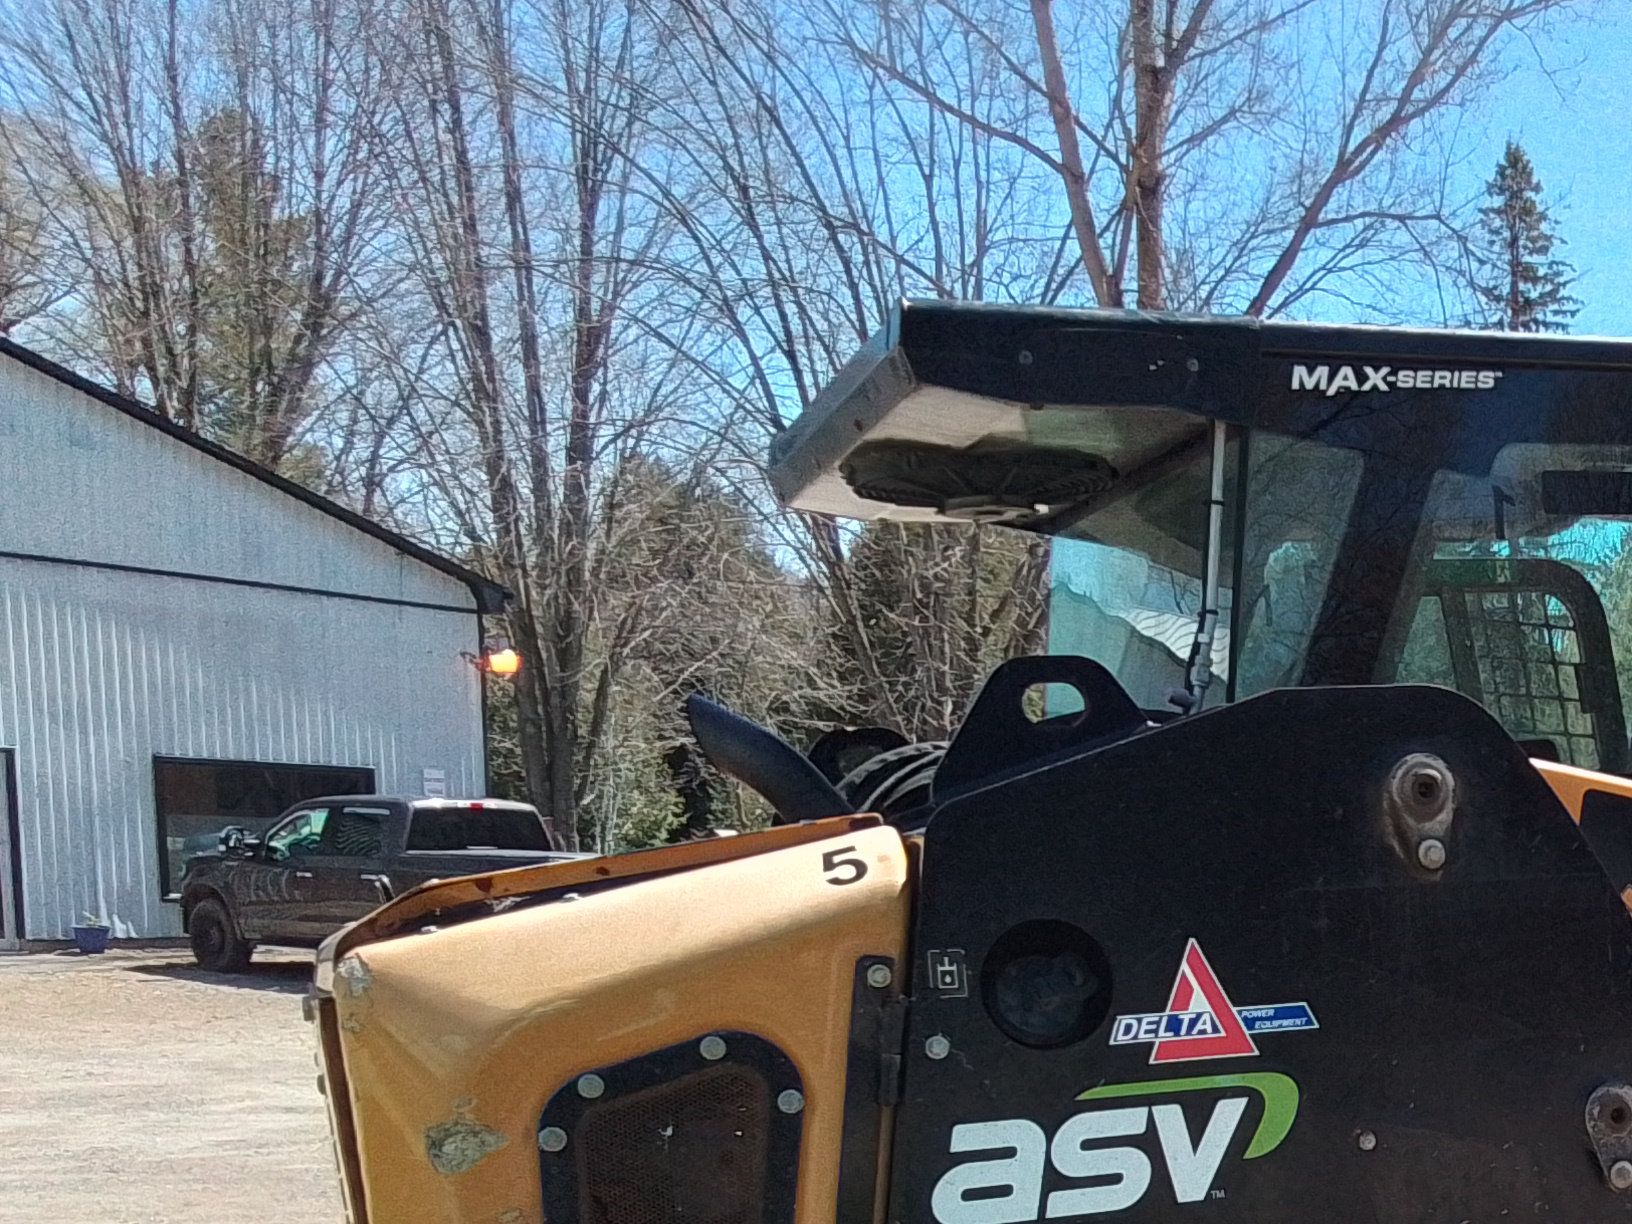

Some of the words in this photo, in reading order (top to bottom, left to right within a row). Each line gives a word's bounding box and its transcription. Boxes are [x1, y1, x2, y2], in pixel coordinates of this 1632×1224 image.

[1291, 364, 1496, 397] MAX-SERIES
[822, 845, 868, 886] 5
[1116, 1012, 1213, 1041] DELTA
[1241, 1008, 1275, 1018] POWER
[1254, 1017, 1309, 1029] EQUIPMENT
